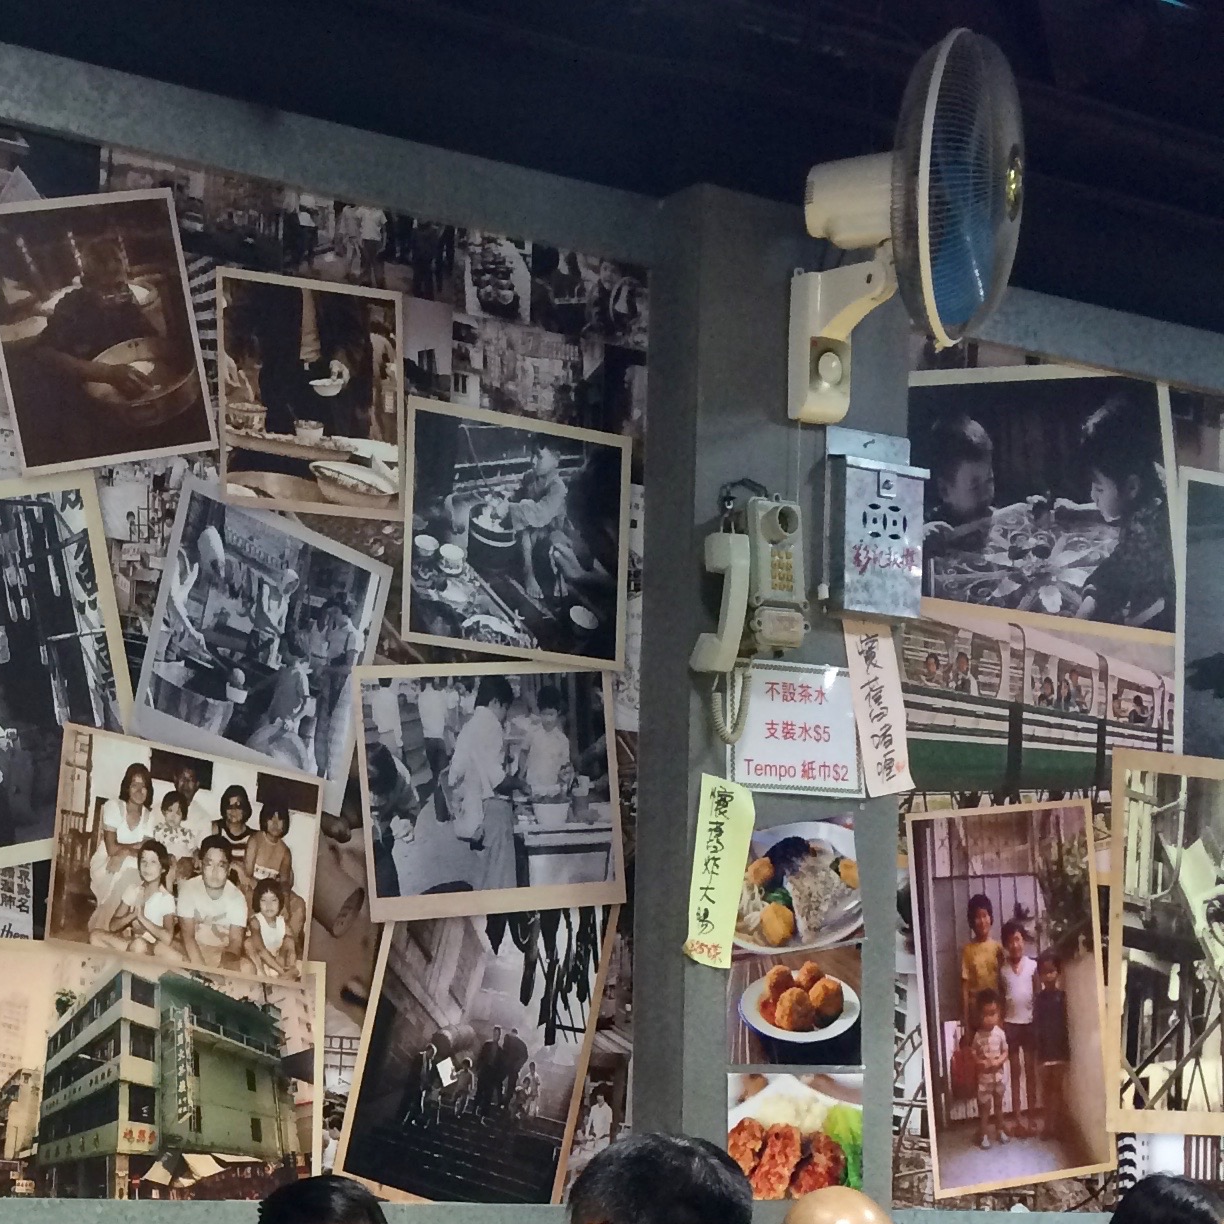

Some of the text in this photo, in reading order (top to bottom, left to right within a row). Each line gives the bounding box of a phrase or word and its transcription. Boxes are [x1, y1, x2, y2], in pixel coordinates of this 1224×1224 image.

[764, 681, 829, 706] 不設茶水
[764, 719, 831, 743] 支裝水$5
[743, 758, 849, 782] Tempo 紙巾$2
